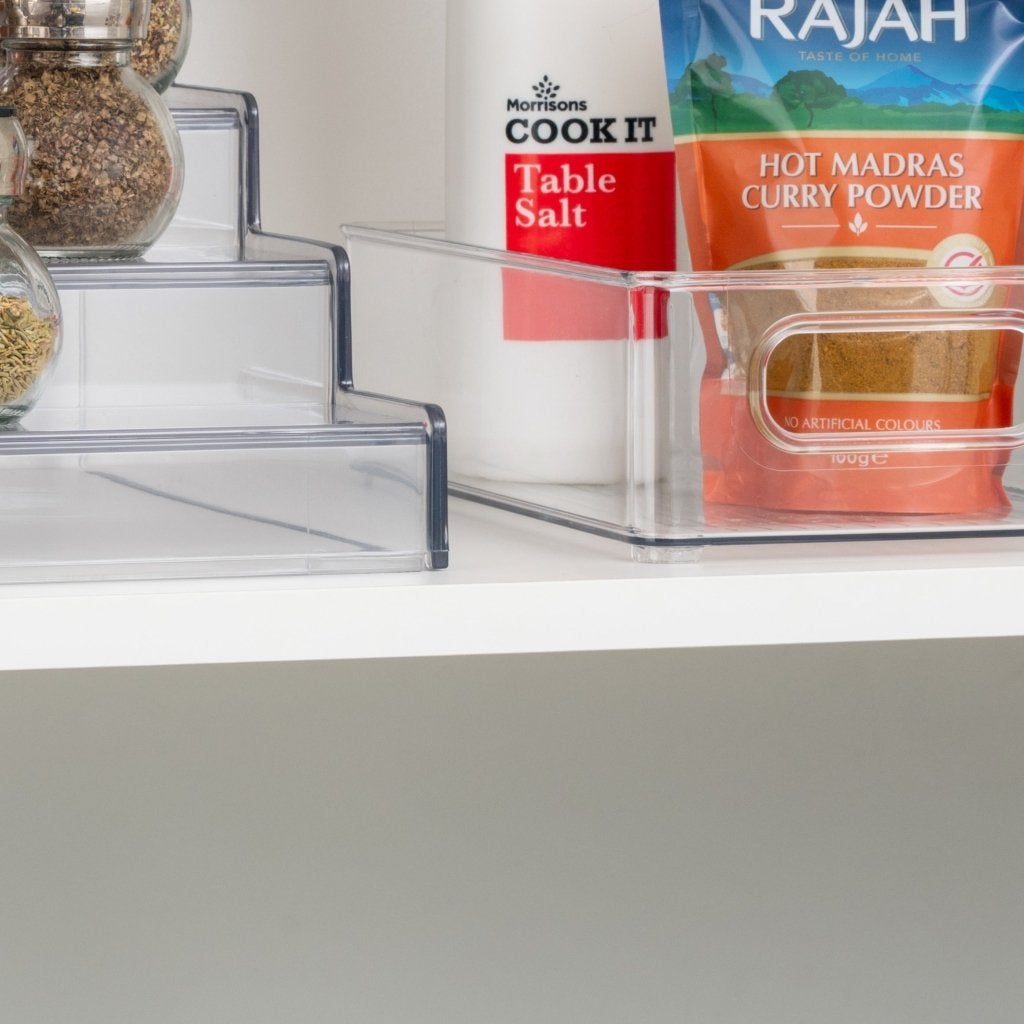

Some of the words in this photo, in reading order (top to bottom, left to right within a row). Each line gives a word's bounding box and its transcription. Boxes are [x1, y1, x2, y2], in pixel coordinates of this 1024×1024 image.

[799, 51, 843, 62] TASTE
[849, 52, 870, 62] OF
[876, 52, 922, 63] HOME
[506, 98, 588, 112] Morrisons
[505, 117, 617, 145] COOK
[624, 116, 657, 143] IT
[759, 152, 822, 178] HOT
[831, 151, 965, 178] MADRAS
[513, 163, 617, 194] Table
[741, 184, 838, 210] CURRY
[847, 183, 984, 210] POWDER
[515, 197, 587, 228] Salt
[784, 416, 799, 428] NO
[802, 418, 872, 431] ARTIFICIAL
[875, 418, 941, 432] COLOURS
